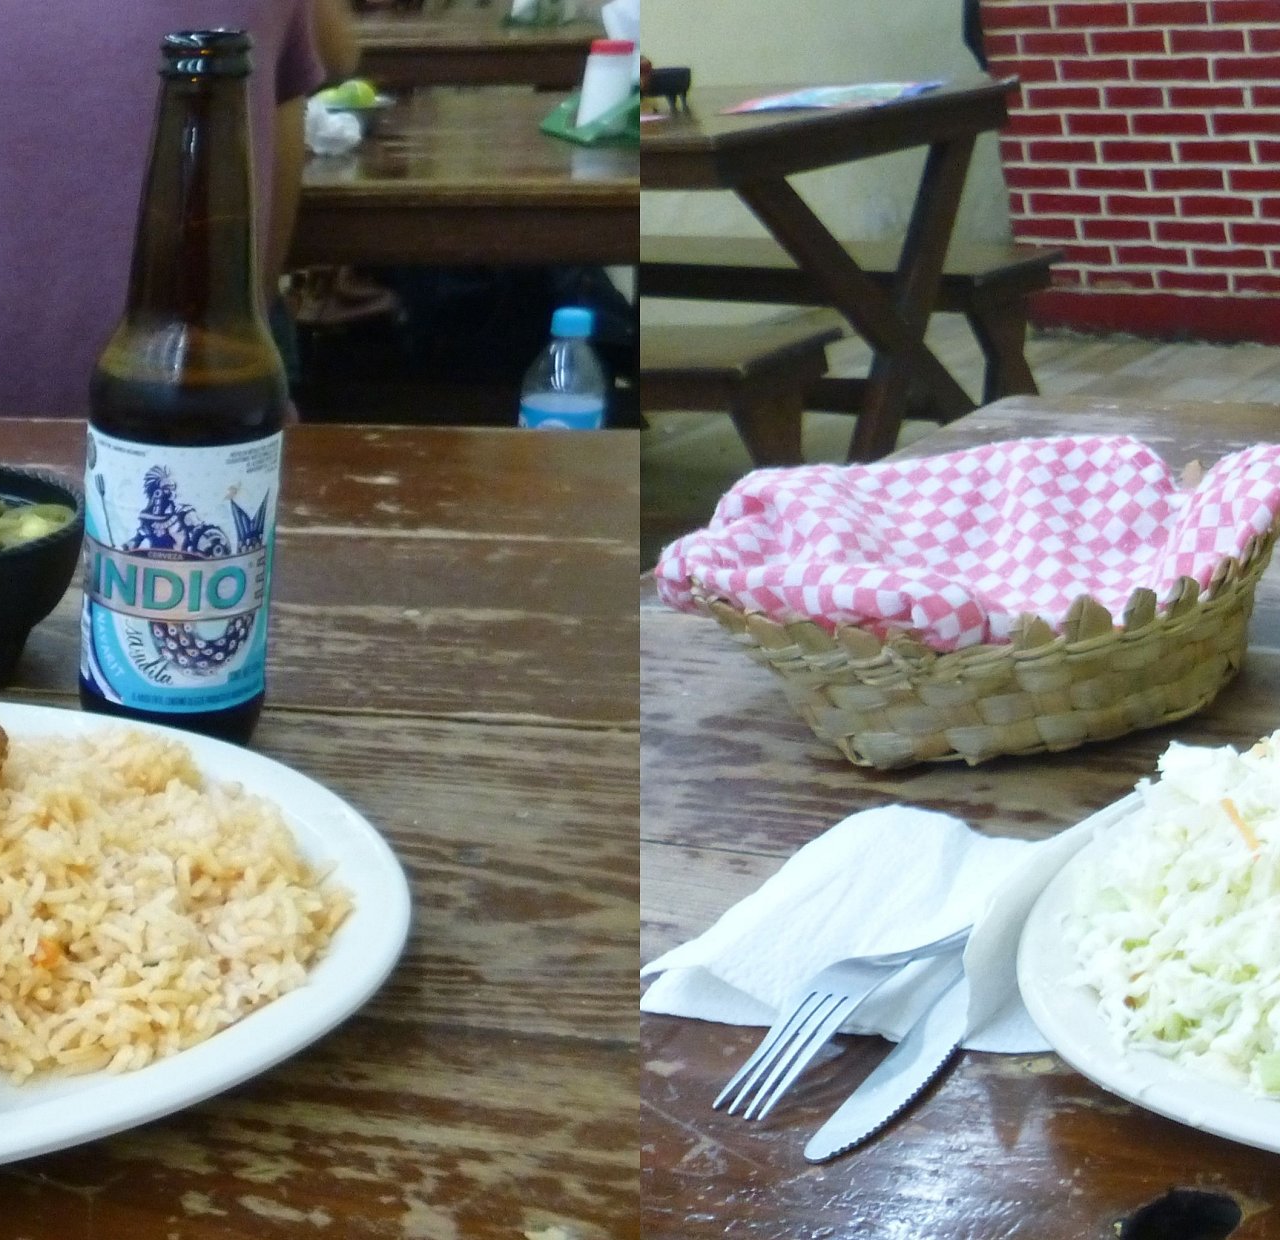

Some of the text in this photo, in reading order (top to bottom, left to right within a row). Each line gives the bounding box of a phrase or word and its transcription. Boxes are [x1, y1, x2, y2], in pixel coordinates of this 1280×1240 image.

[93, 552, 247, 612] INDIO
[147, 551, 184, 561] CERVEZA
[96, 611, 125, 677] NAYARIT
